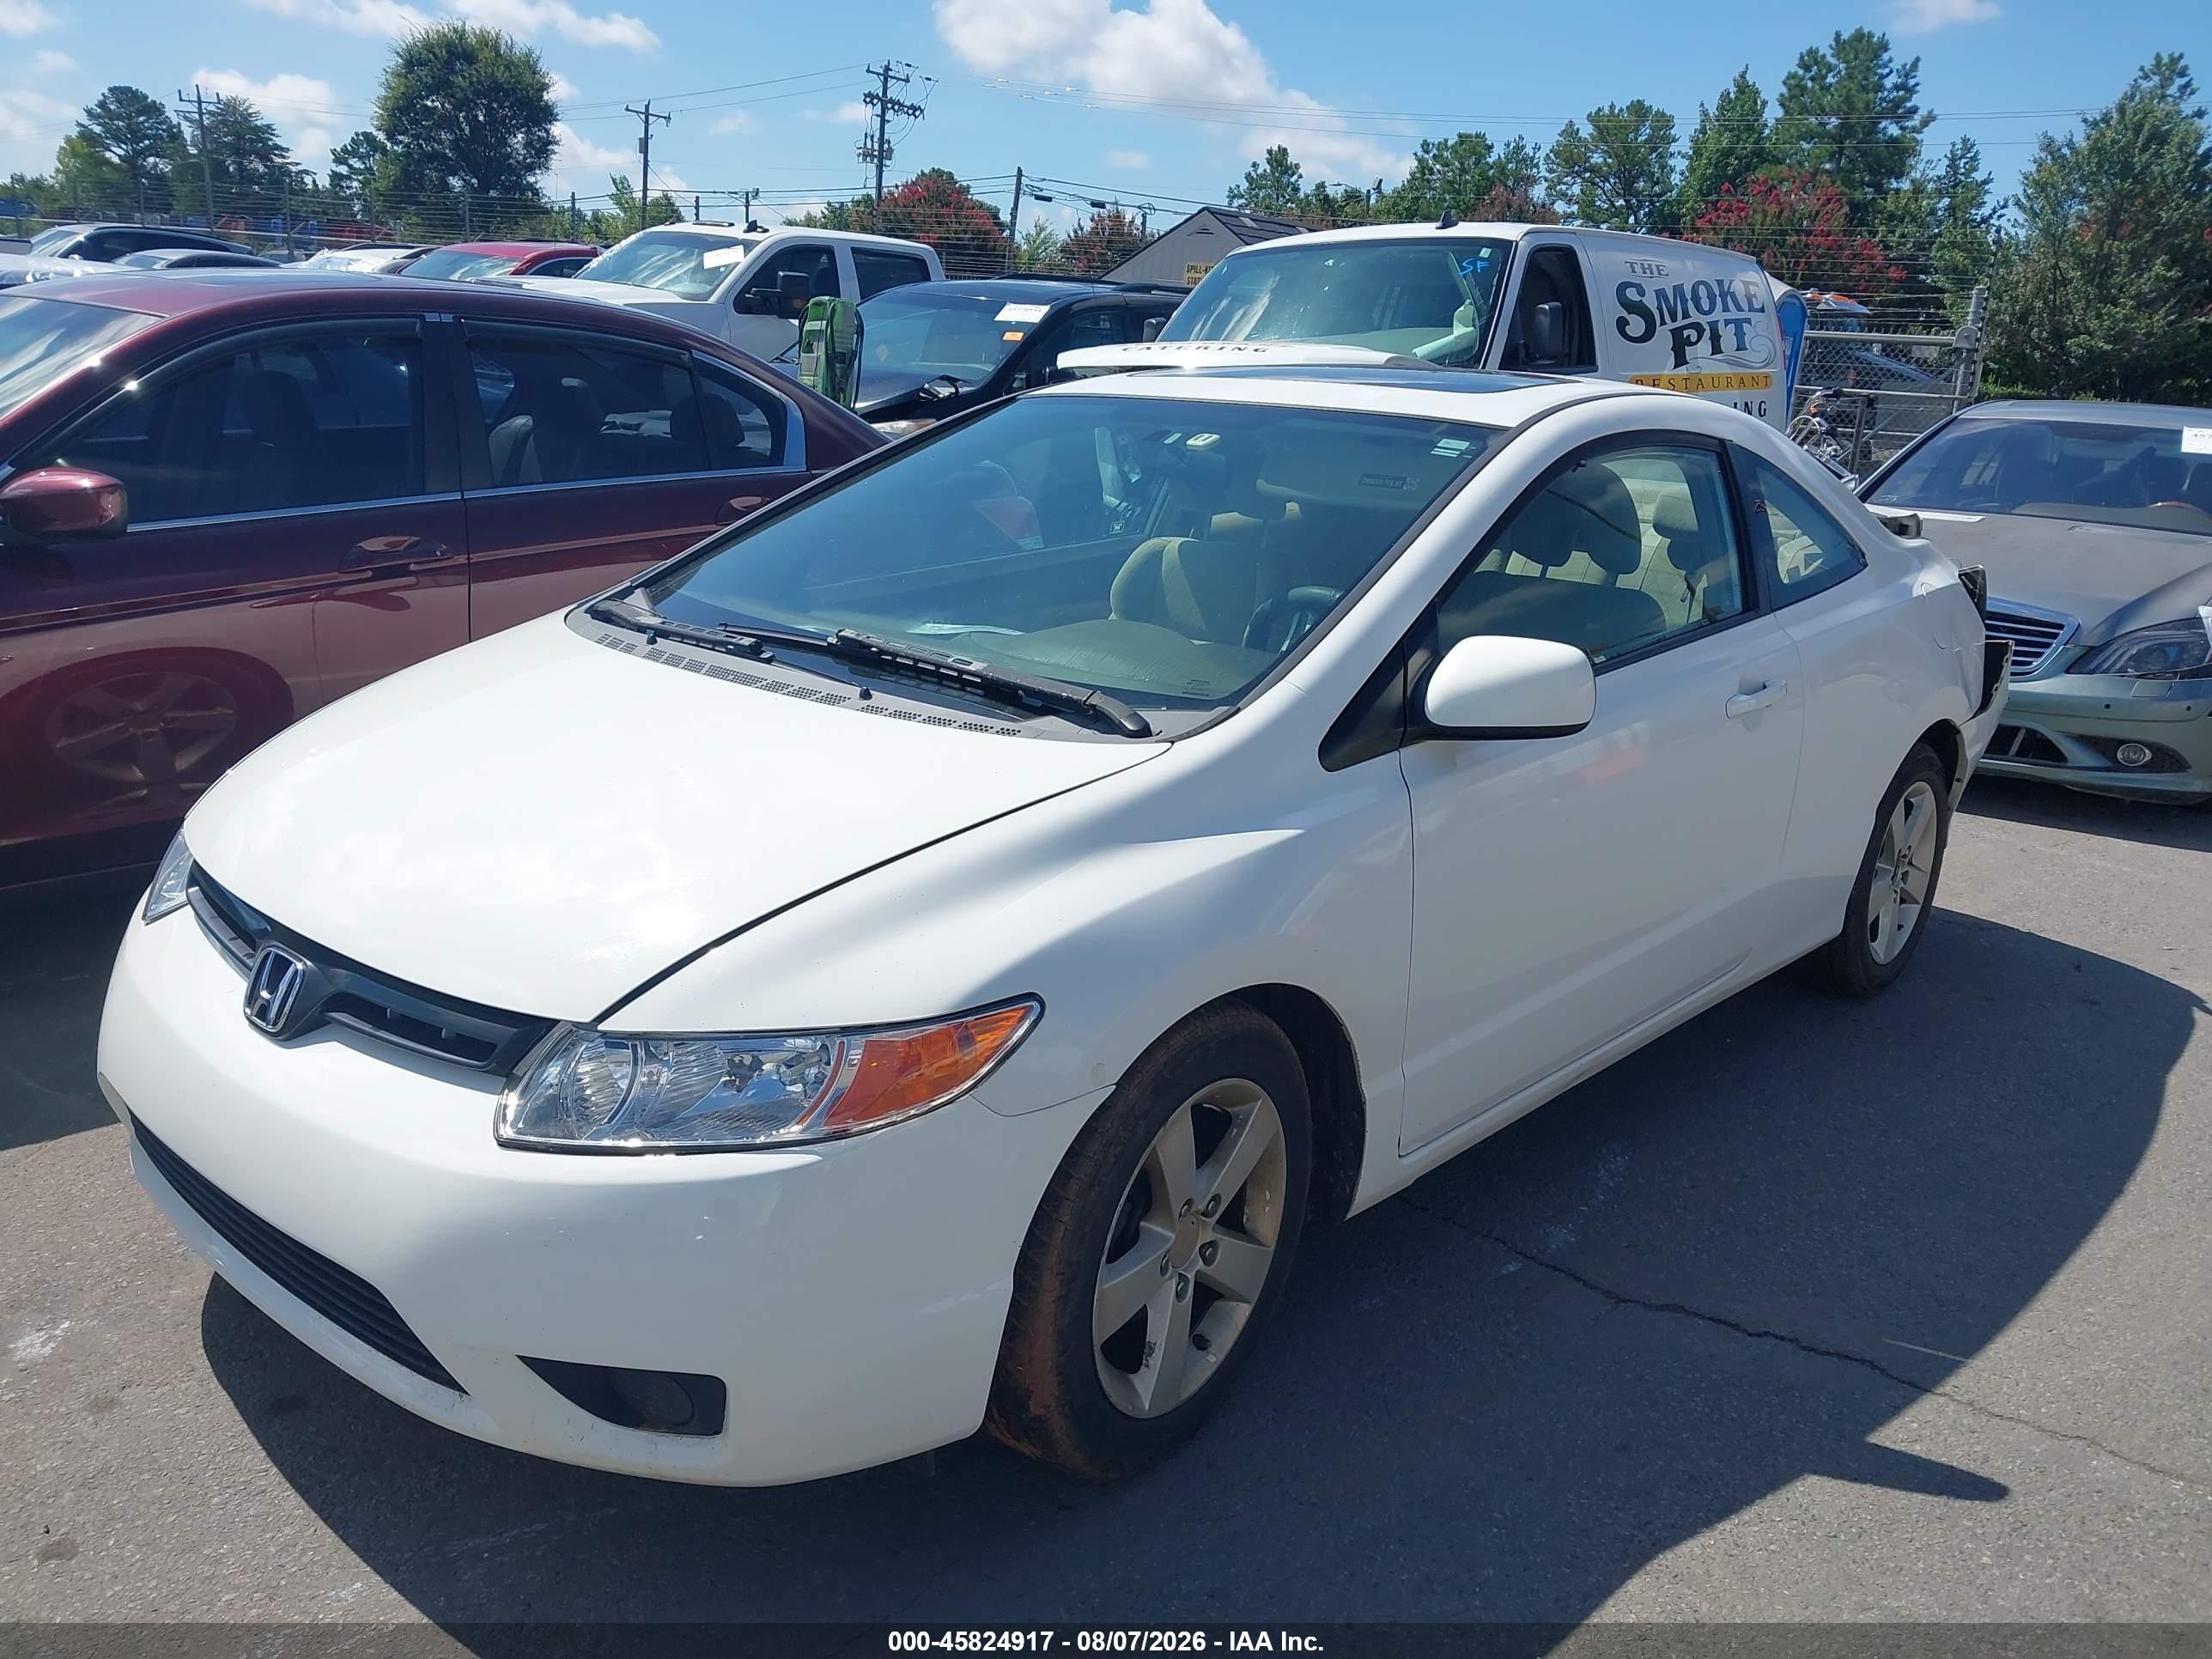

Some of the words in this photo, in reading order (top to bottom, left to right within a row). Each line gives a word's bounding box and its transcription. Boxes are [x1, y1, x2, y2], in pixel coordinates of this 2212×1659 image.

[1186, 276, 1203, 286] STAT
[1624, 260, 1669, 276] THE
[1615, 278, 1765, 344] SMOKE
[1668, 317, 1753, 370] PIT
